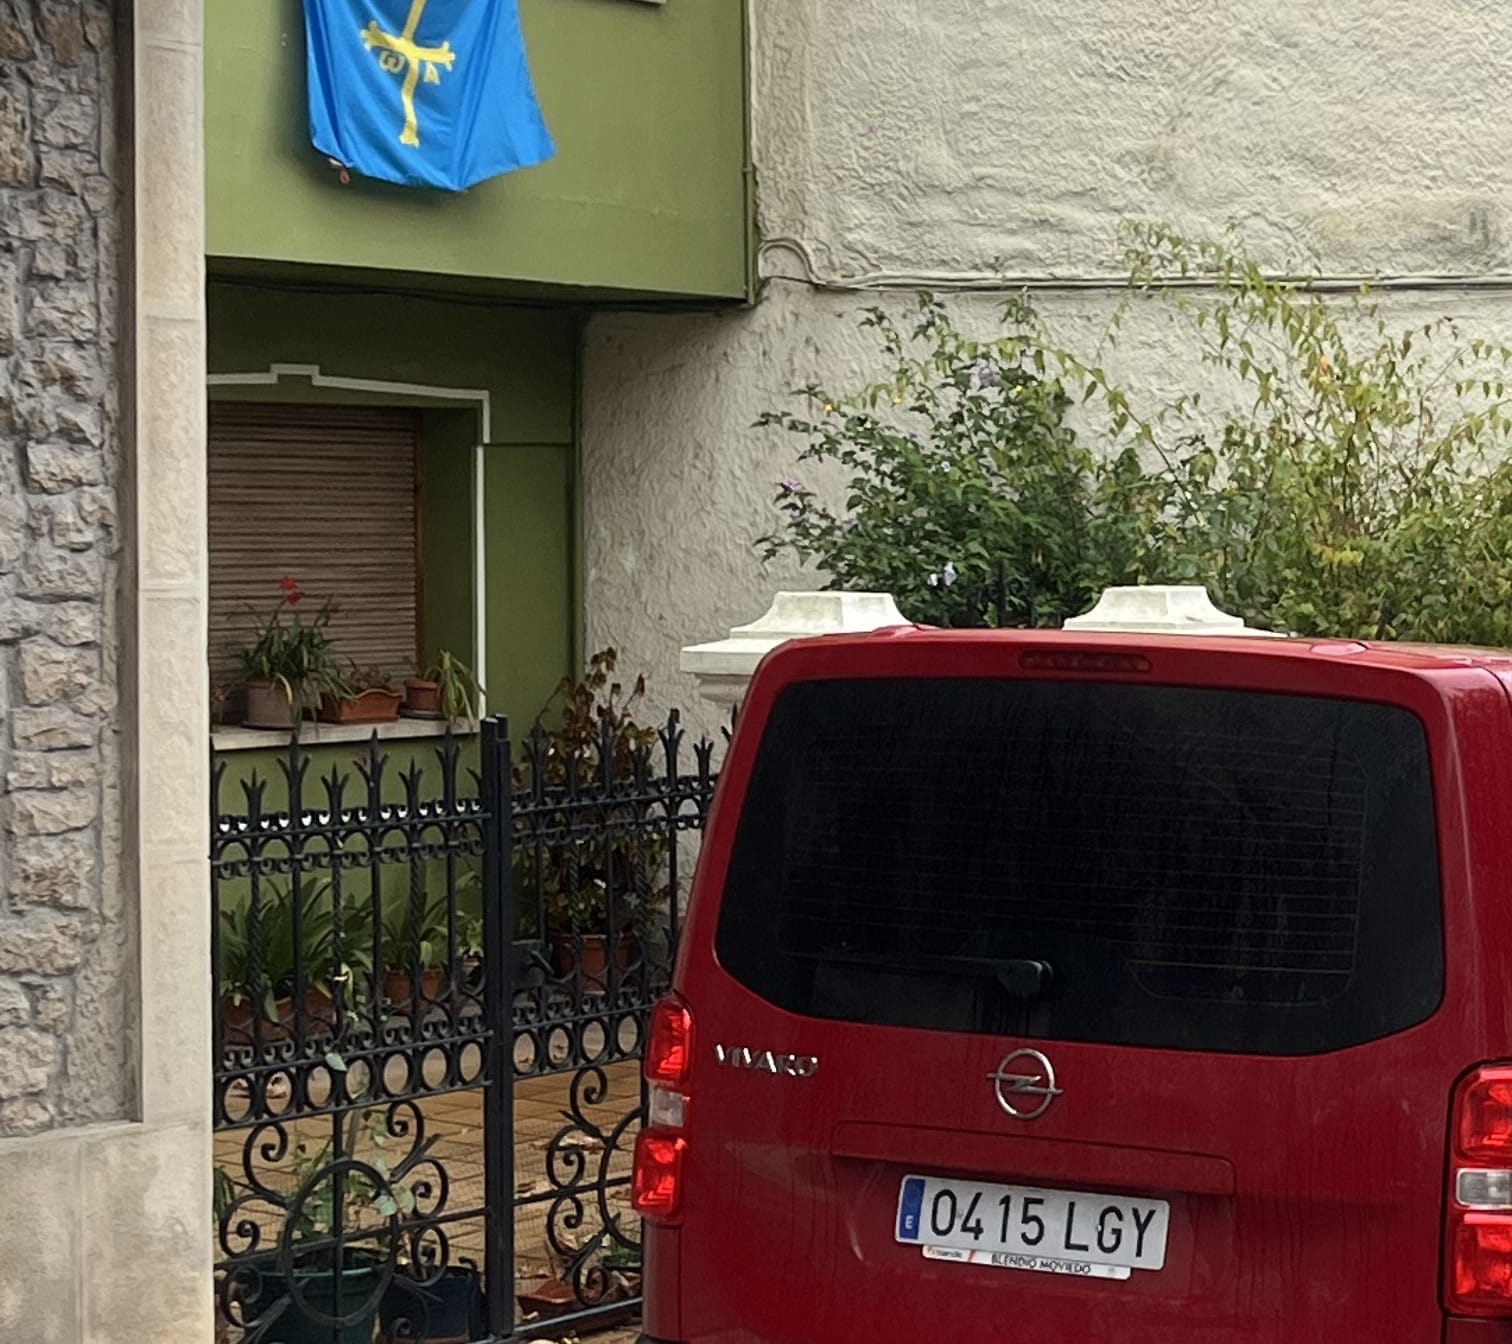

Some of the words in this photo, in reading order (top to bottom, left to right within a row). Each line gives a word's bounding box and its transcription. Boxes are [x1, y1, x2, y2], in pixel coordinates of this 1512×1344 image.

[715, 1043, 819, 1078] VIVARO
[904, 1215, 914, 1231] E
[930, 1188, 1046, 1246] 0415
[1063, 1200, 1157, 1258] LGY
